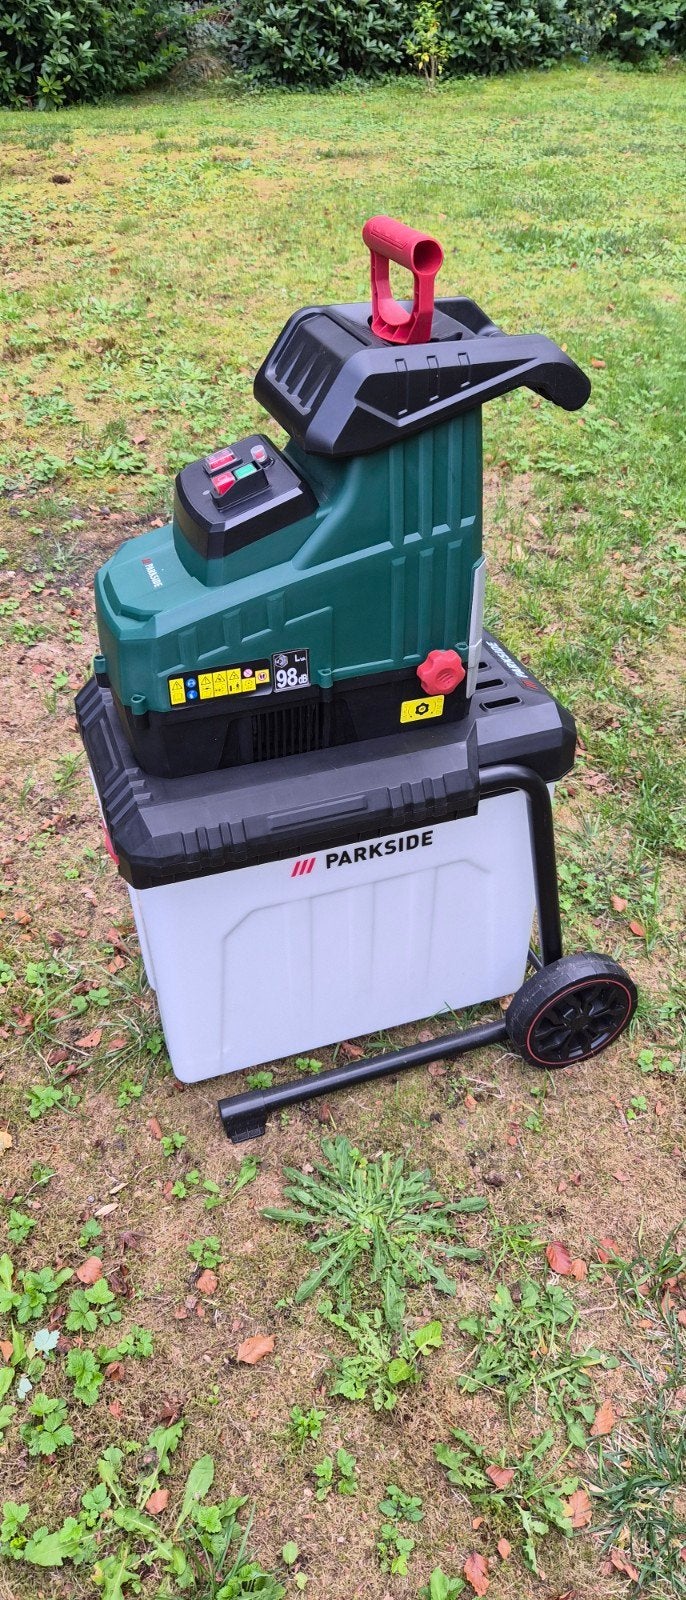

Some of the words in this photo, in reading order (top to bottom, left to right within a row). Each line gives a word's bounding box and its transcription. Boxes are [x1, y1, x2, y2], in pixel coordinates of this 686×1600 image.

[144, 563, 163, 588] PARKSIDE
[485, 641, 528, 678] PARKSIDE
[326, 830, 434, 869] PARKSIDE
